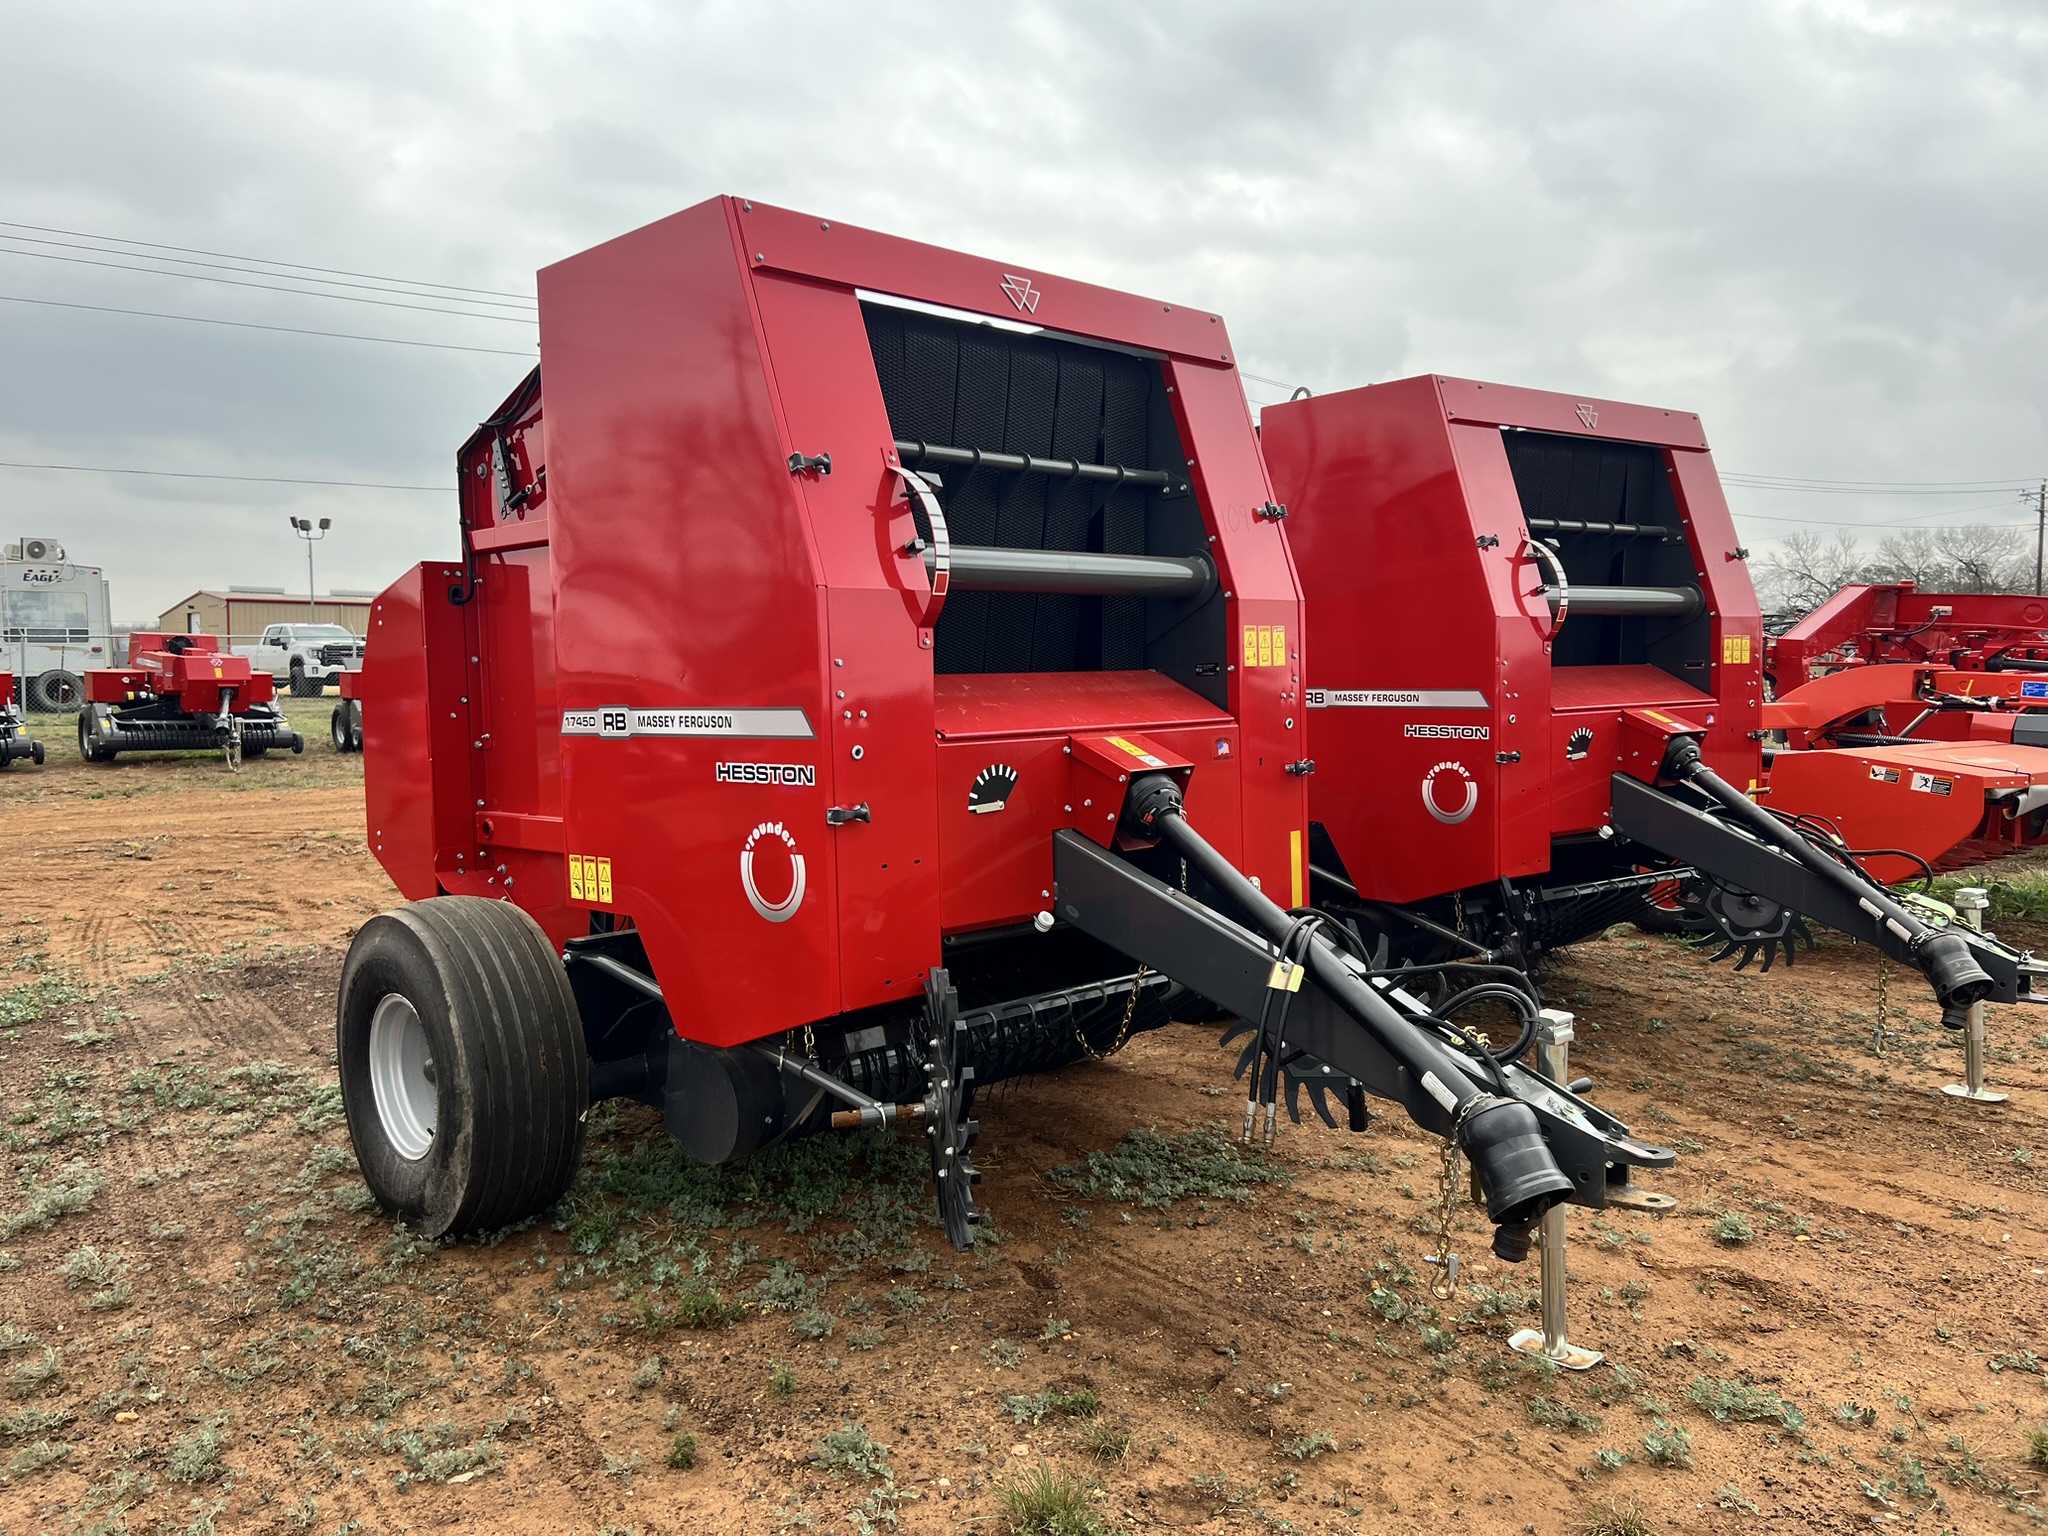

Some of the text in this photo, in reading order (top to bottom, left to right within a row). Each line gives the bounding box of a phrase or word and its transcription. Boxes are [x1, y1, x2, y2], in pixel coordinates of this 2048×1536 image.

[1334, 693, 1369, 702] MASSEY
[1371, 693, 1420, 703] FERGUSON
[564, 712, 733, 732] 1745D RB MASSEY FERGUSON
[1404, 724, 1489, 740] HESSTON
[715, 761, 816, 786] HESSTON
